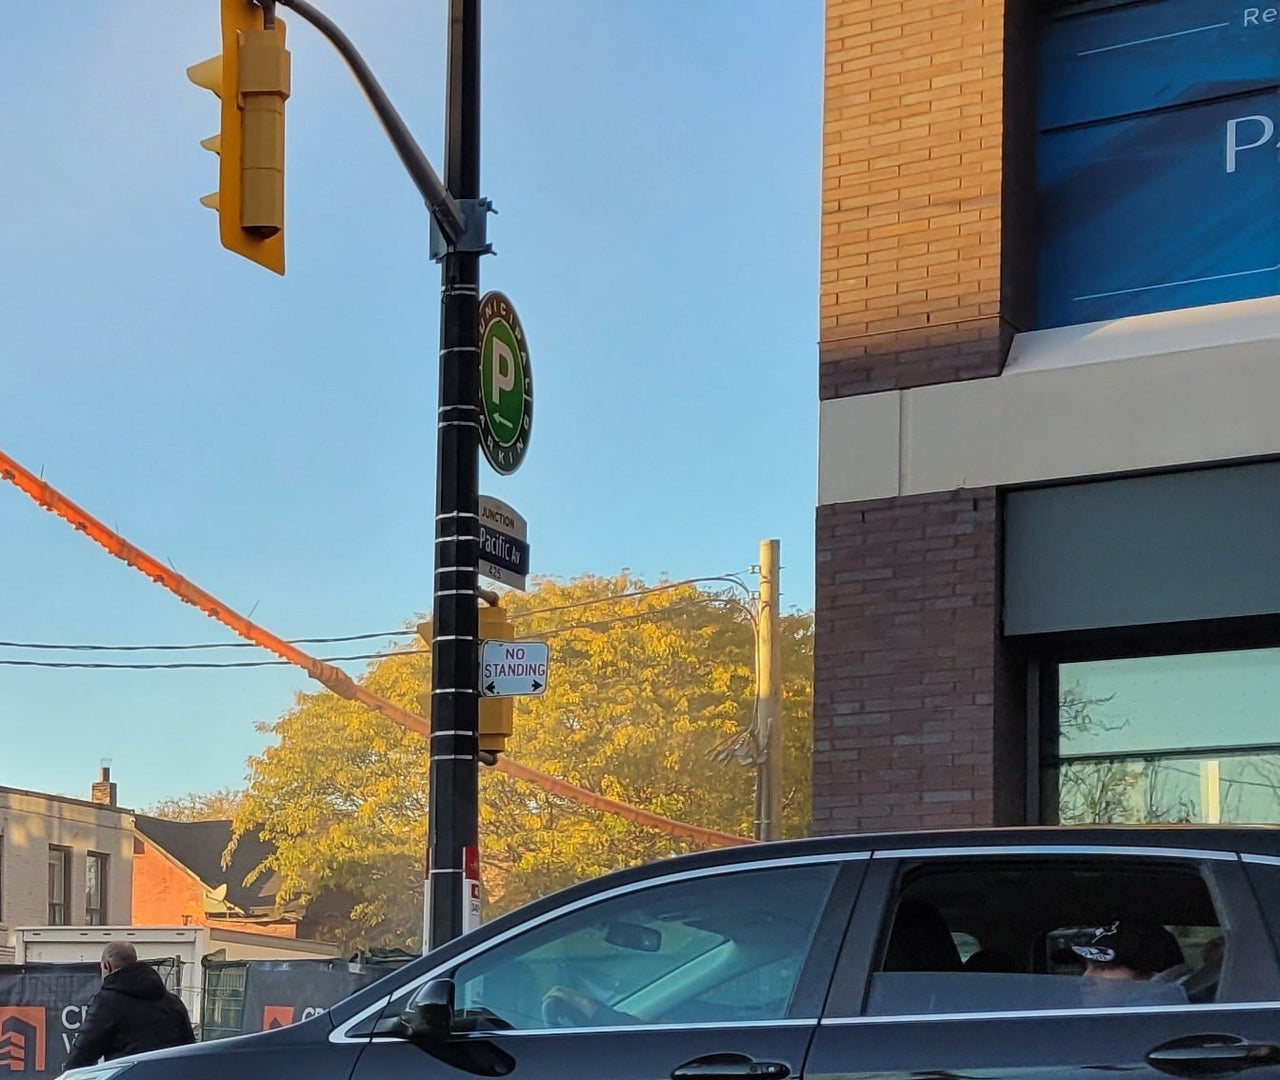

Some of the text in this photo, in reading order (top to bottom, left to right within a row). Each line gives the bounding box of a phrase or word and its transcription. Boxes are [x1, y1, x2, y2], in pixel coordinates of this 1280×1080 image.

[1226, 115, 1280, 173] P
[492, 336, 515, 405] P
[481, 506, 515, 530] JUNCTION
[479, 527, 521, 565] Pacific Av
[505, 648, 525, 661] NO
[484, 663, 545, 679] STANDING
